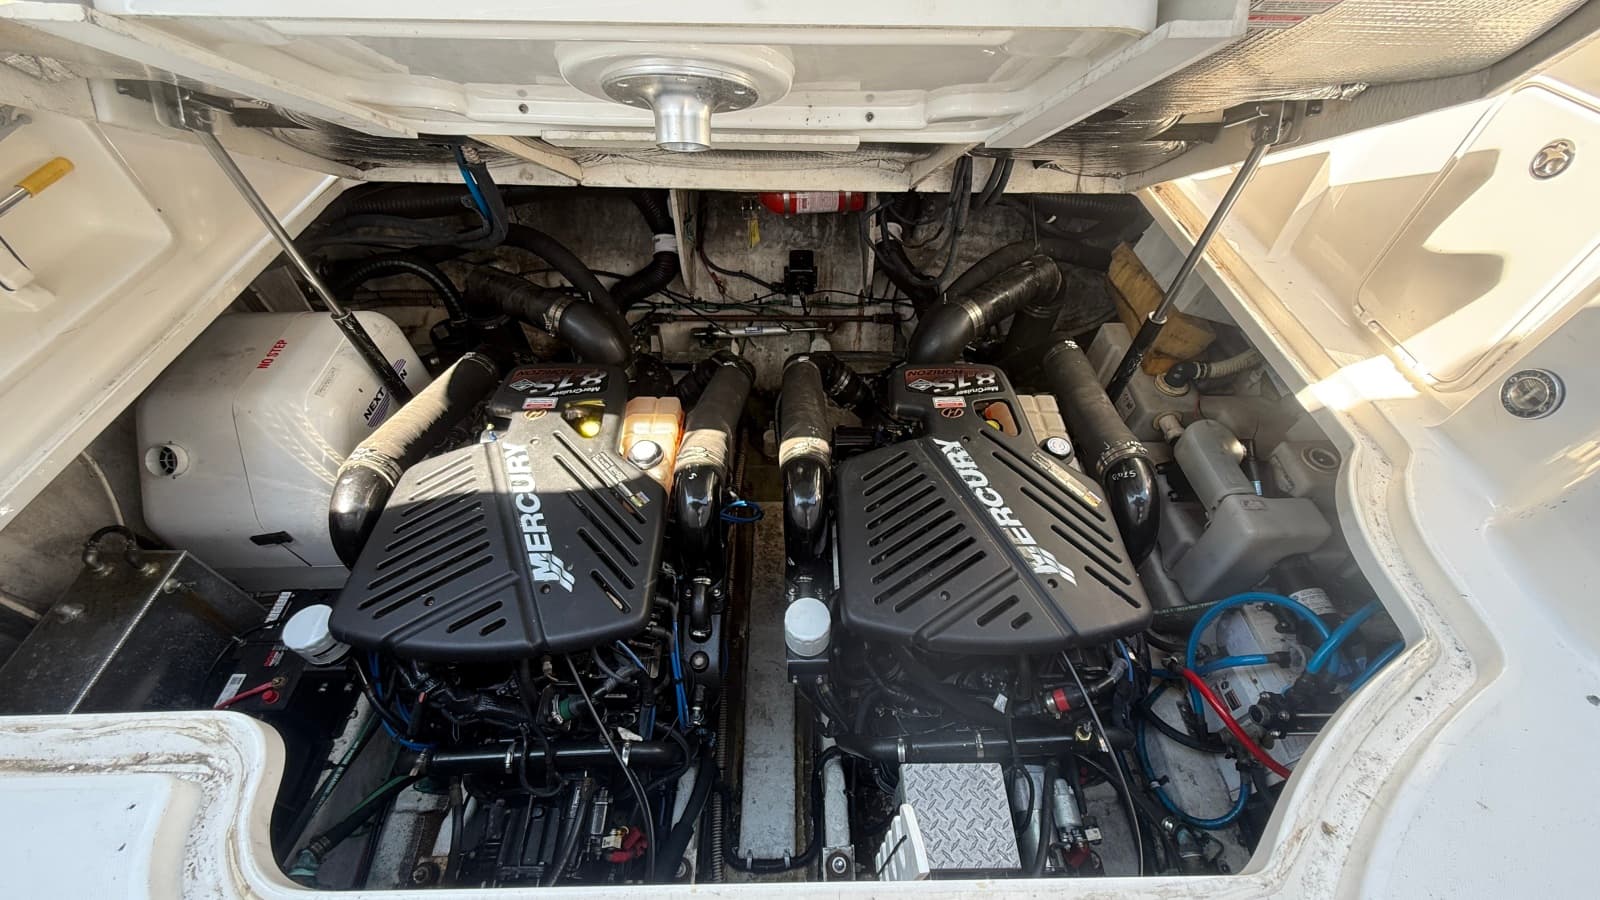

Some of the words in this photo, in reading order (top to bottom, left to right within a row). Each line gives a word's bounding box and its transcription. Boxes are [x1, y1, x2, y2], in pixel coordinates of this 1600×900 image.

[256, 357, 274, 369] NO
[267, 339, 288, 358] STEP
[907, 369, 965, 377] HORIZON
[363, 386, 386, 420] NEXT
[547, 386, 601, 397] MerCruiser
[955, 385, 999, 396] MerCruiser
[502, 442, 566, 586] MERCURY
[932, 438, 1062, 576] MERCURY
